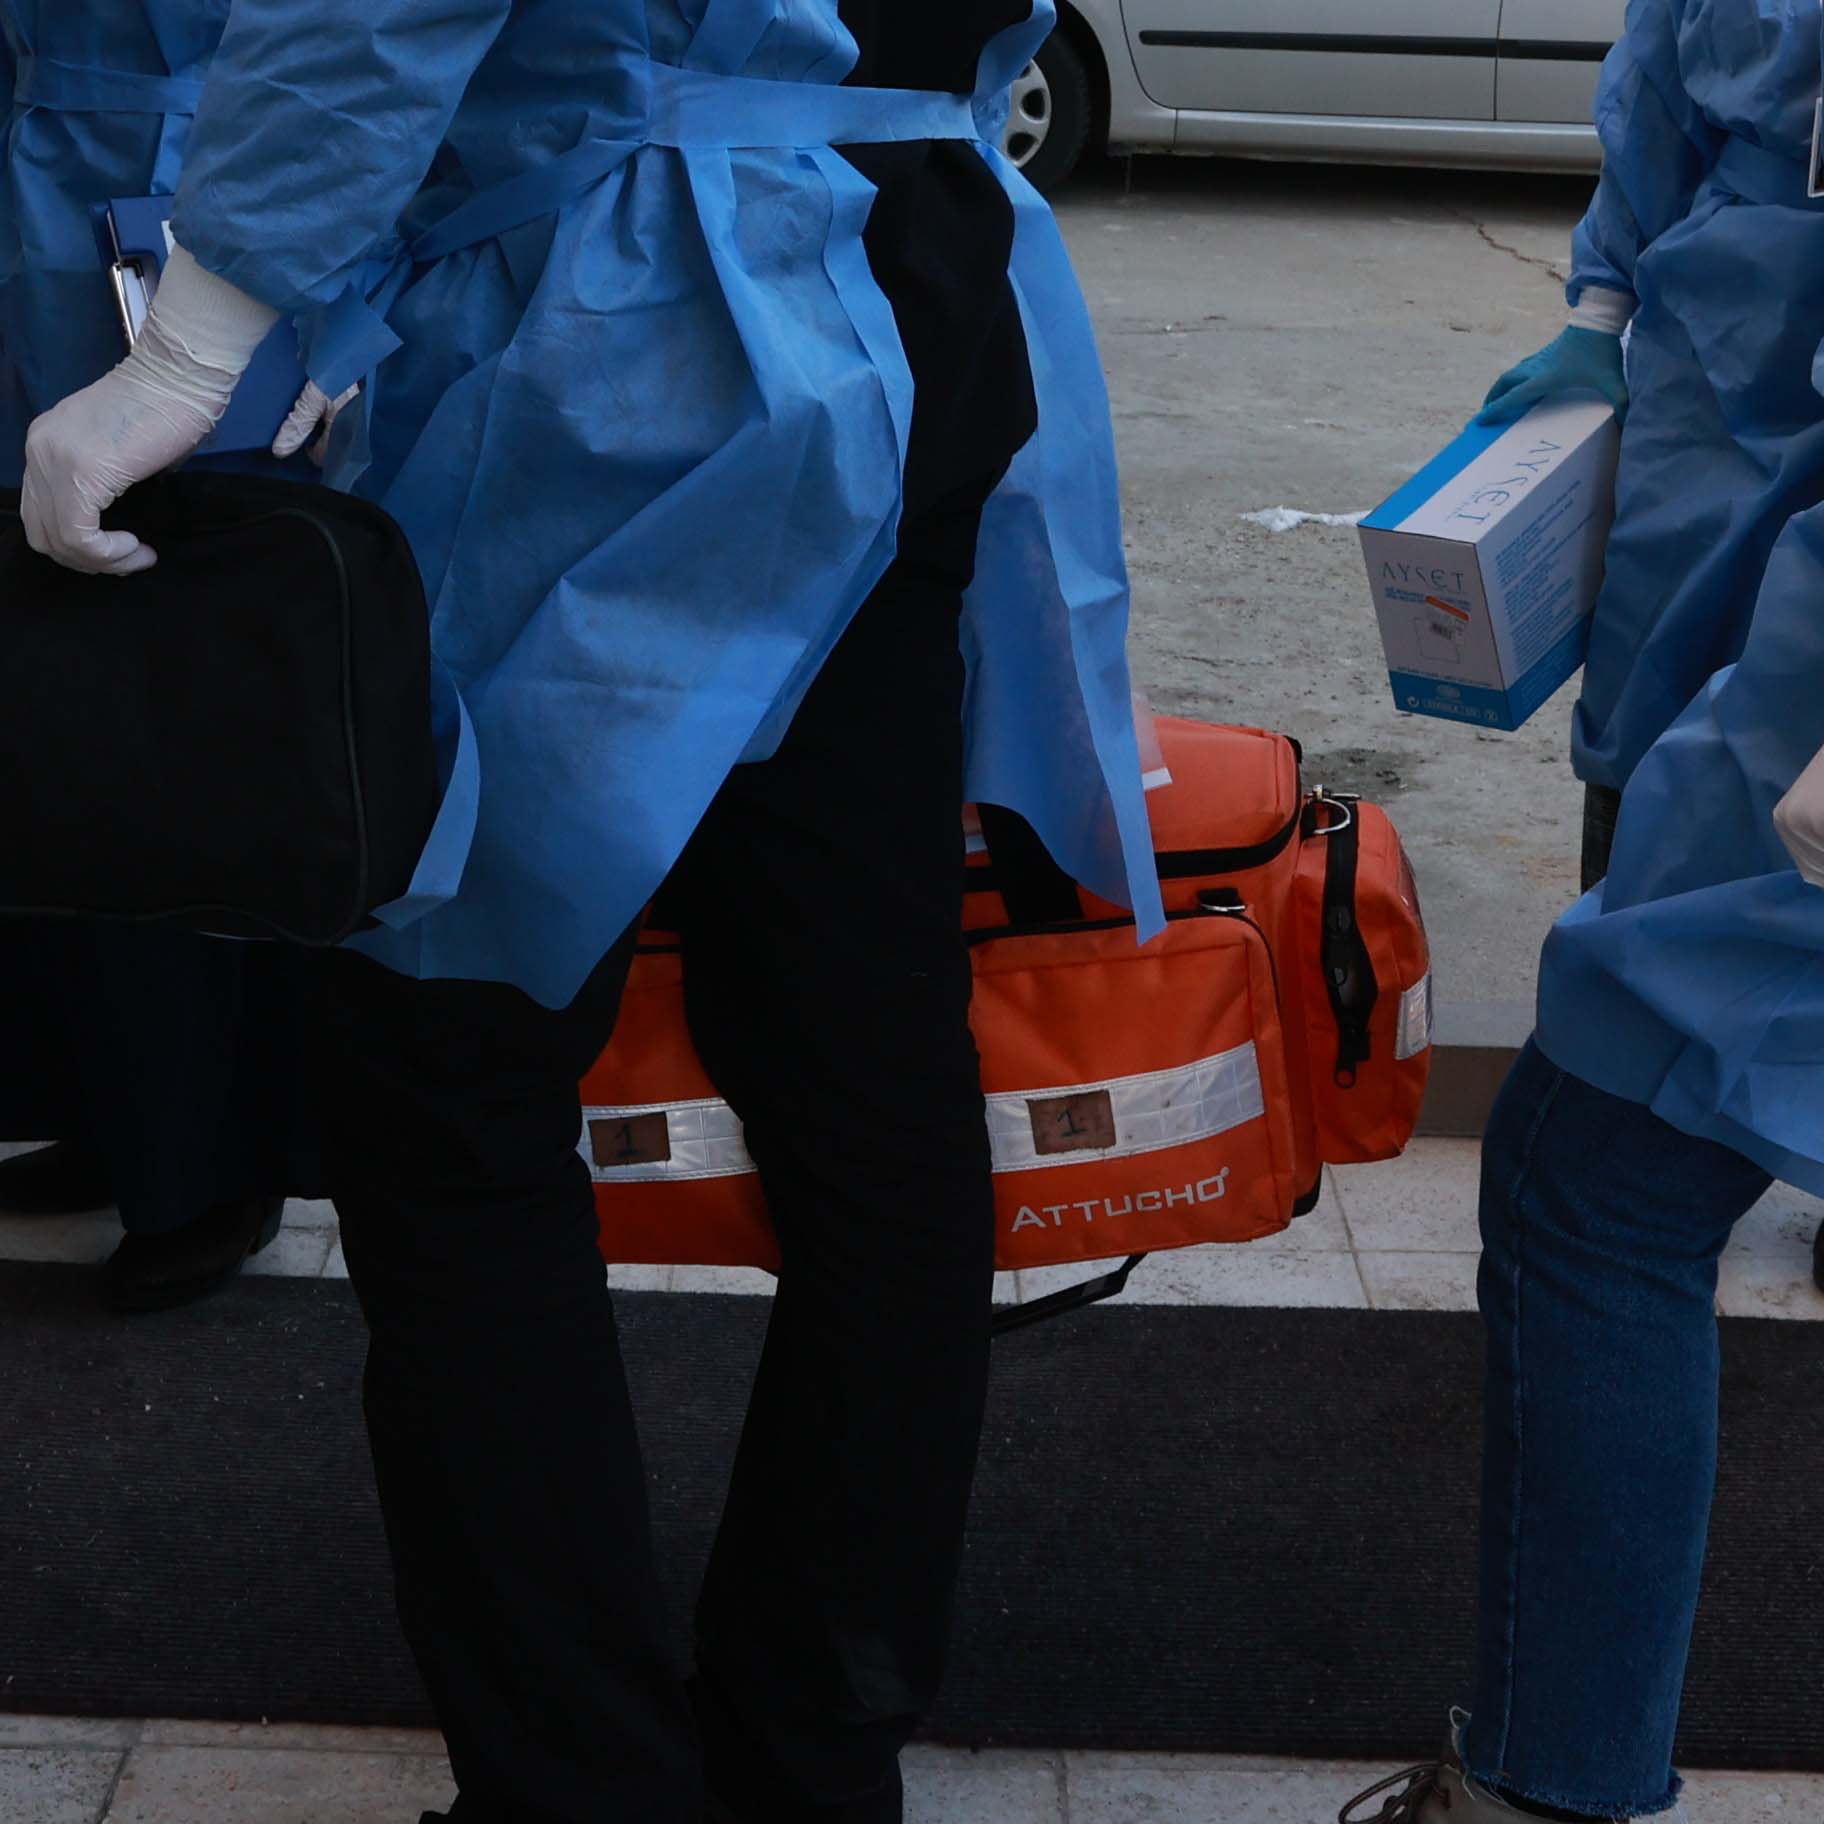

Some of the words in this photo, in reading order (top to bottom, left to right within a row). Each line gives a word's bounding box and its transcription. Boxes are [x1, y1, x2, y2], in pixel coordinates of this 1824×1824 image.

[615, 1122, 647, 1158] 1
[1056, 1107, 1087, 1138] 1
[1011, 1173, 1227, 1233] ATTUCHO
